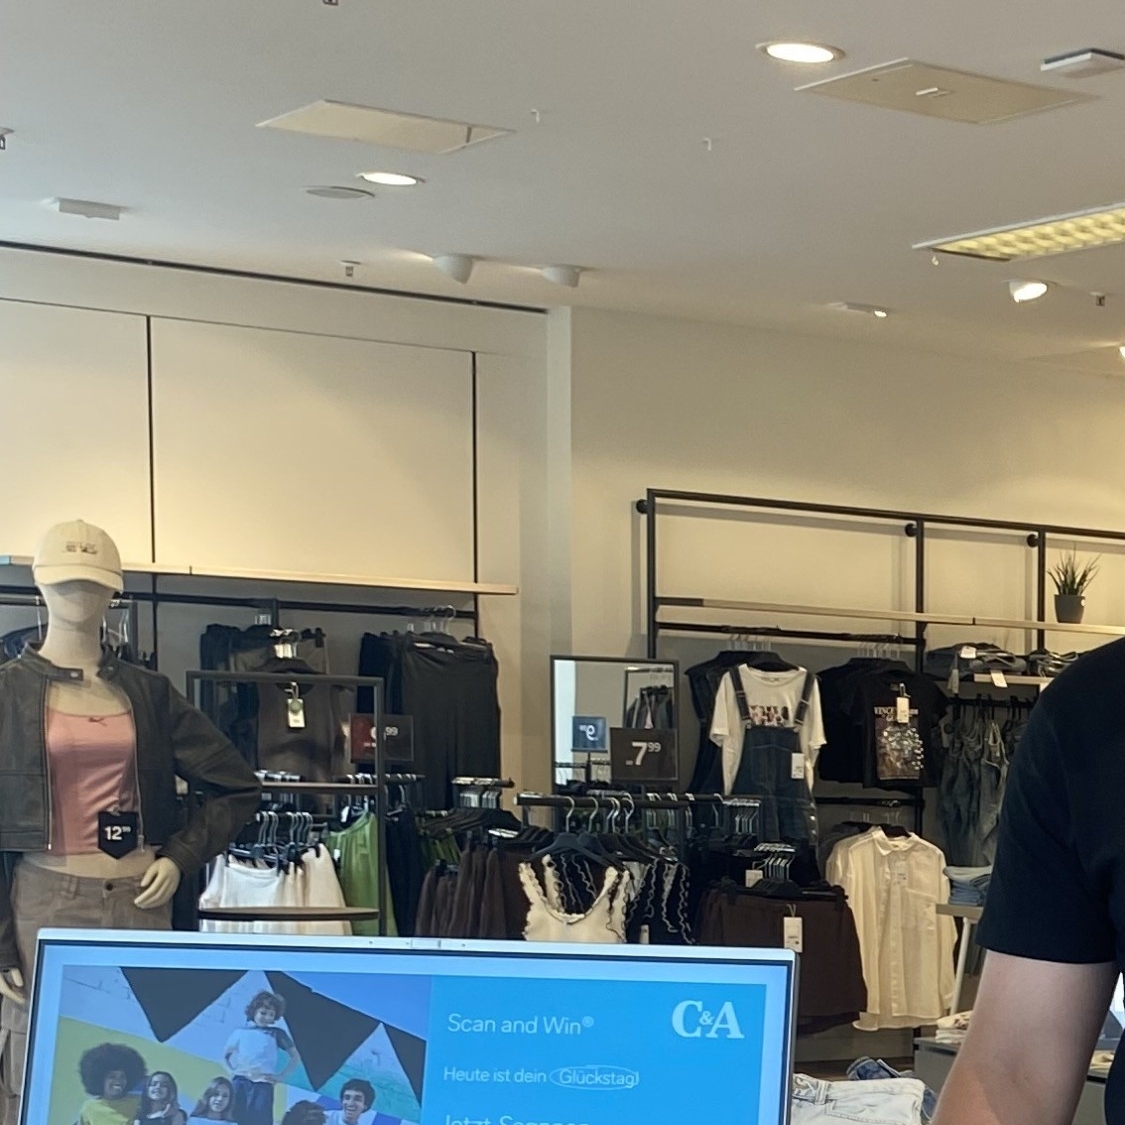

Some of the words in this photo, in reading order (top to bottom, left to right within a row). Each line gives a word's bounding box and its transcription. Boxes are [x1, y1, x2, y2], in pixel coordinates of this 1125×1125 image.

[448, 1013, 497, 1033] Scan
[501, 1016, 538, 1035] and
[671, 1000, 745, 1039] C&A
[443, 1066, 490, 1083] Heute
[492, 1069, 511, 1084] ist
[513, 1069, 548, 1085] dein
